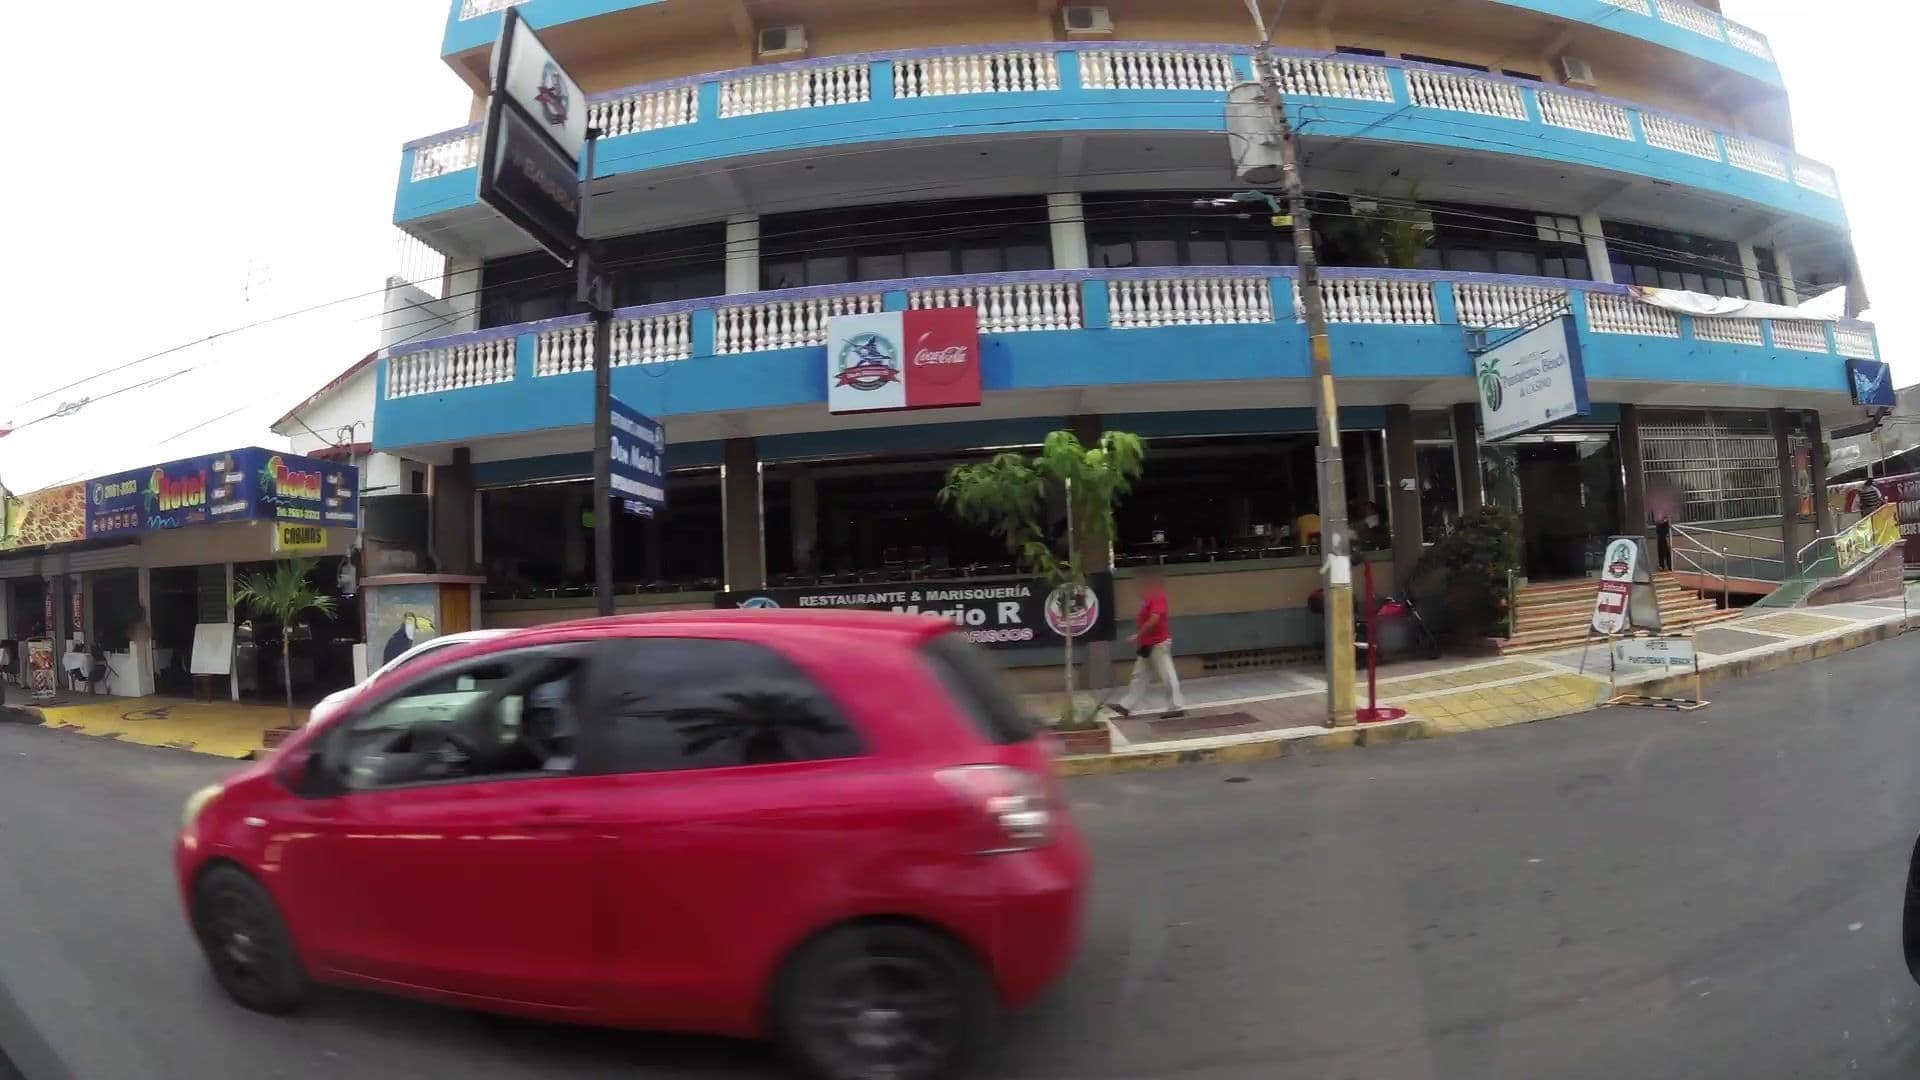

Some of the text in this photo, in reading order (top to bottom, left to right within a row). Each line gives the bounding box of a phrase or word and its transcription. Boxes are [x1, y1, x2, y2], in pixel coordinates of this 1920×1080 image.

[914, 346, 968, 366] Coca-Cola
[283, 527, 322, 545] CABINAS
[799, 584, 1031, 607] RESTAURANTE & MARISQUERÍA
[997, 601, 1023, 625] R
[962, 627, 1034, 643] RISCOS
